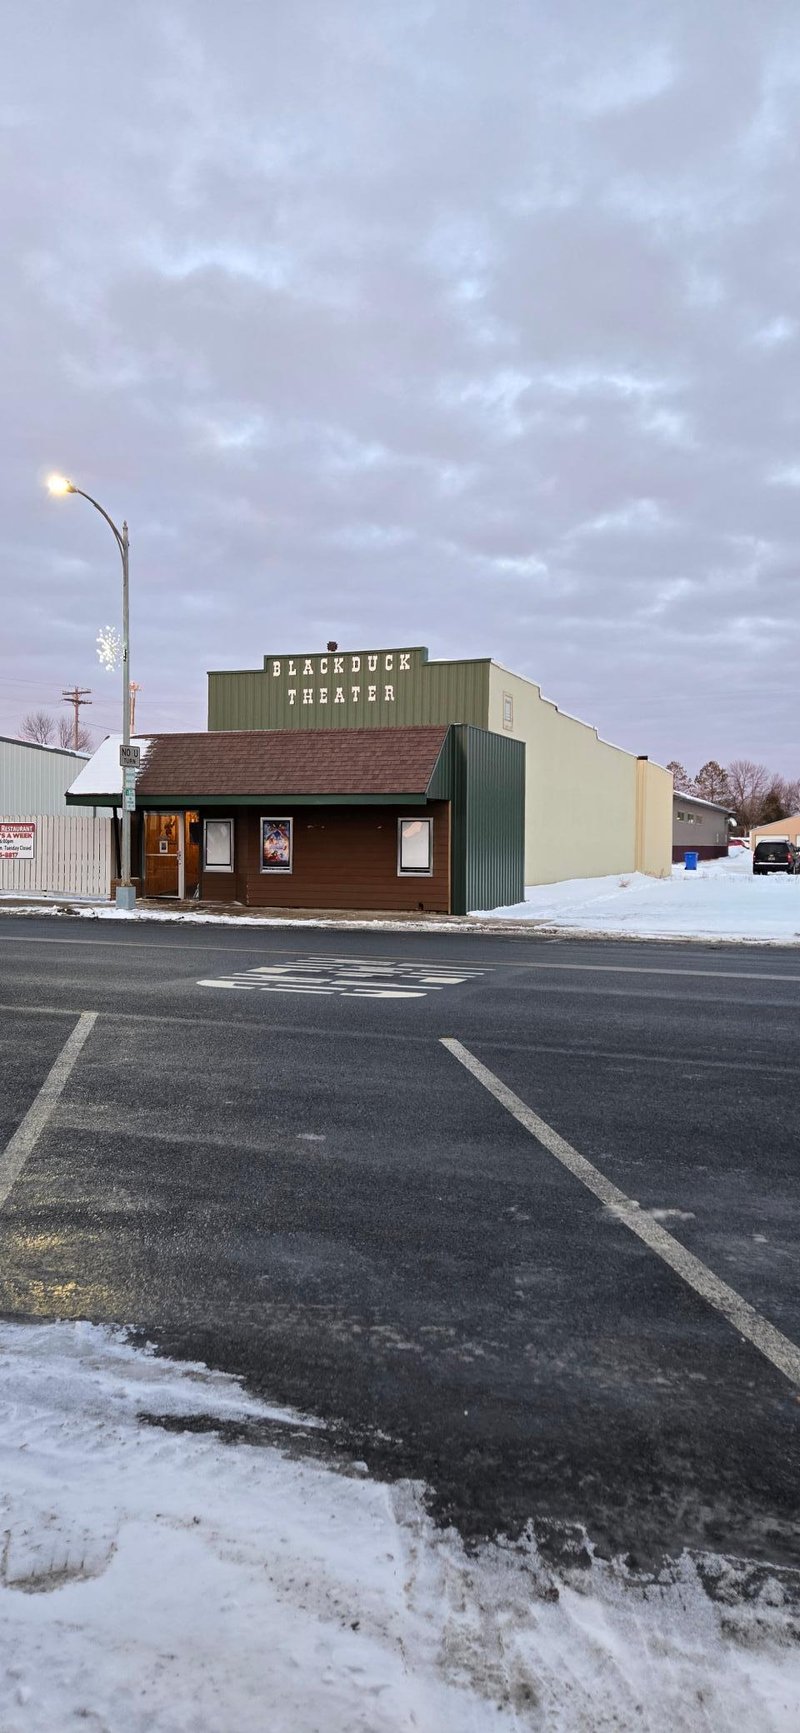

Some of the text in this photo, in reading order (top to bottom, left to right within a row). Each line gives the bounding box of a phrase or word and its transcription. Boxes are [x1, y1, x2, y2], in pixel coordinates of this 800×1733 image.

[272, 653, 411, 677] BLACKDUCK
[288, 685, 395, 705] THEATER
[122, 748, 139, 757] NO U
